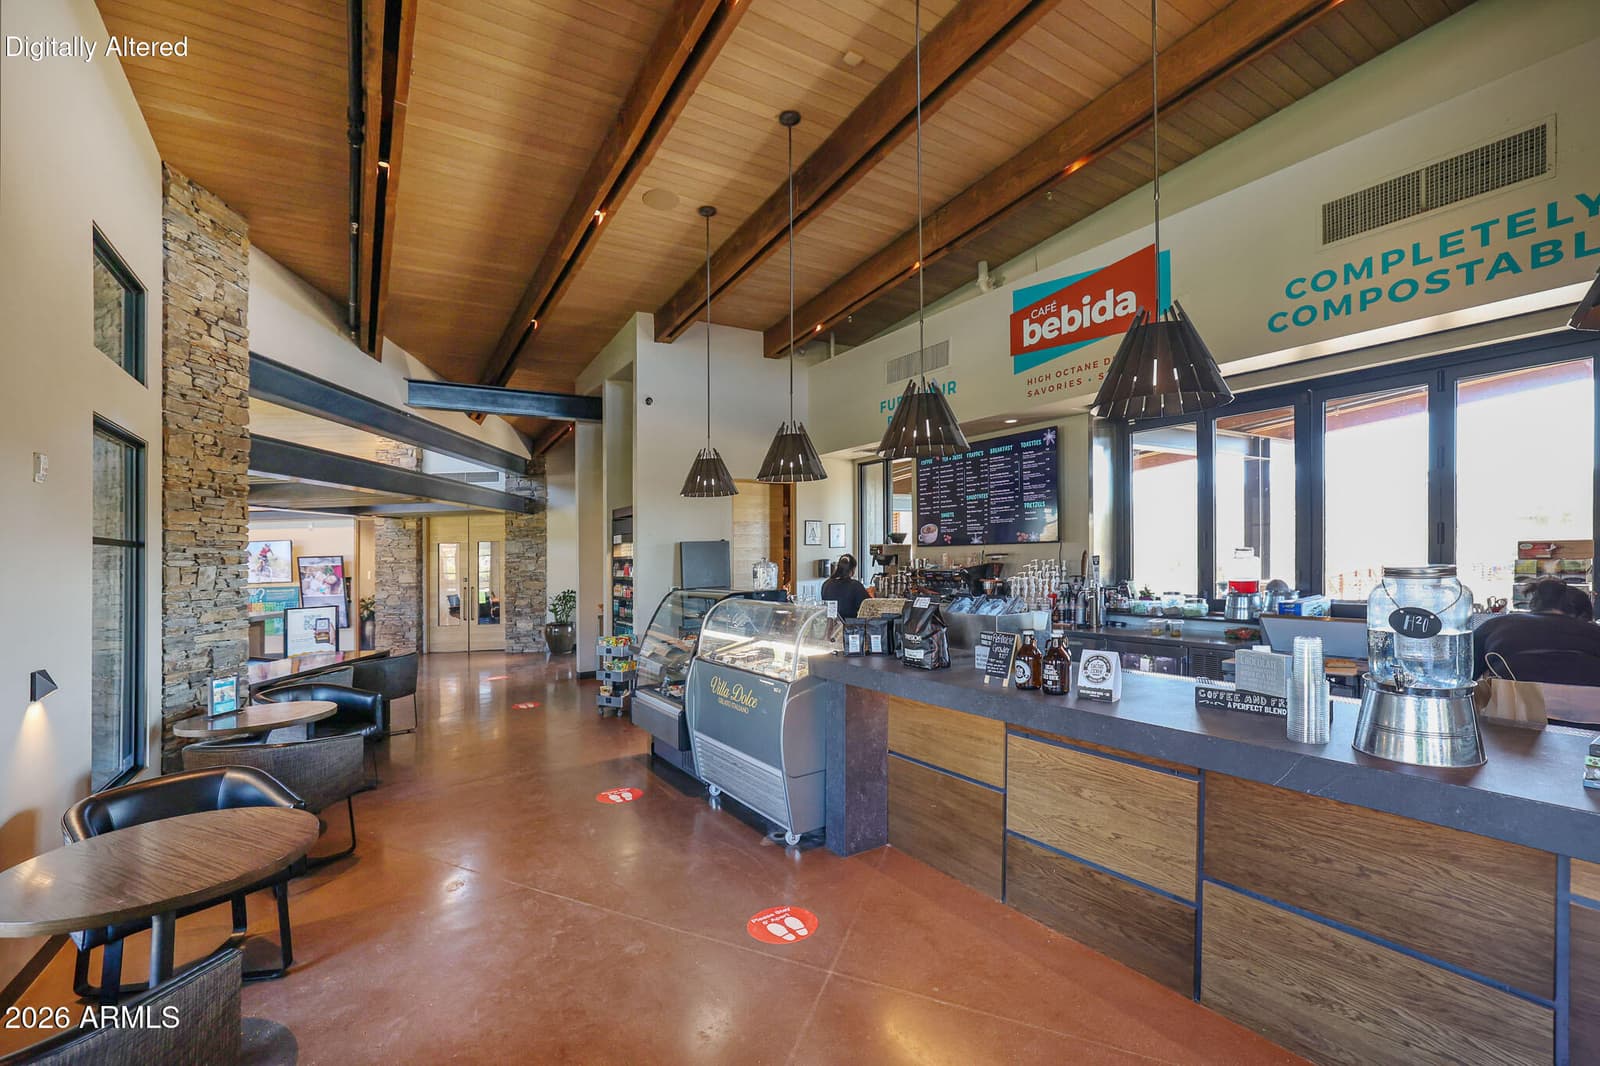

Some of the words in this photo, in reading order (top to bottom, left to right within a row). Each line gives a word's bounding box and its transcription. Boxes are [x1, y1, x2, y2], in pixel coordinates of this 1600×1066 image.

[1023, 288, 1137, 347] bebida
[1030, 300, 1057, 319] CAFÉ
[1027, 373, 1051, 386] HIGH
[1055, 360, 1099, 378] OCTANE
[1027, 378, 1082, 398] SAVORIES
[989, 444, 1013, 455] BREAKFAST
[711, 676, 730, 698] Villa
[731, 683, 758, 708] Dolce
[1199, 689, 1241, 703] COFFEE
[1244, 694, 1267, 706] AND
[1233, 702, 1263, 713] PERFECT
[1264, 706, 1287, 715] BLEND
